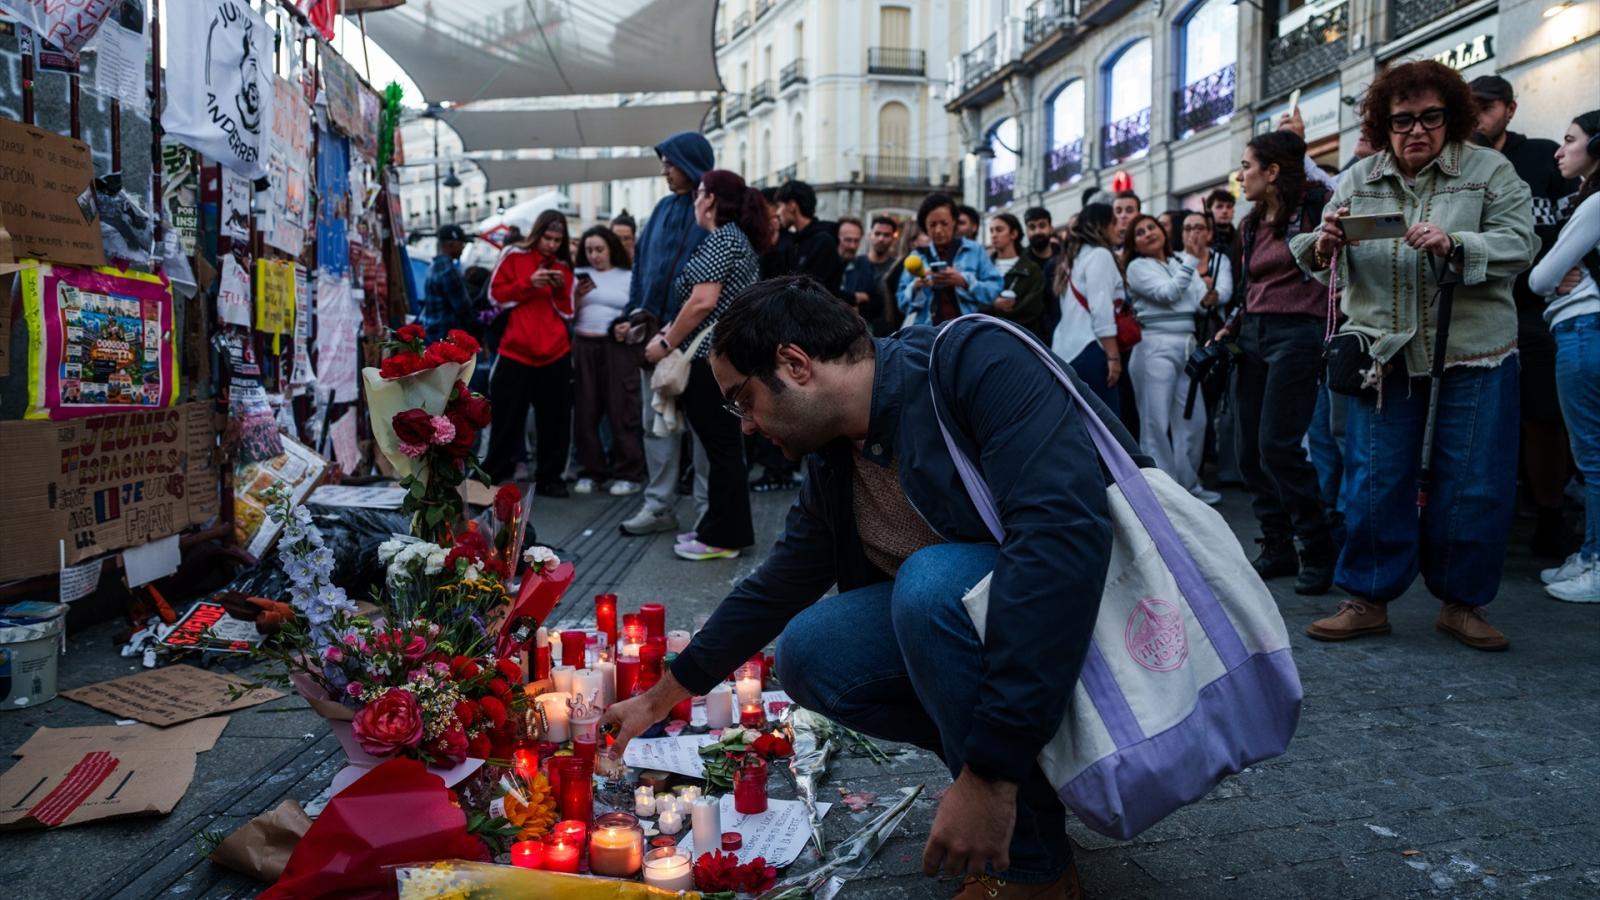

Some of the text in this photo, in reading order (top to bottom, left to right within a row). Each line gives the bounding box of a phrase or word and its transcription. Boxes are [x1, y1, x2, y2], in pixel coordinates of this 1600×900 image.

[206, 92, 259, 163] ANDERREN
[80, 409, 180, 457] JEUNES
[79, 448, 178, 485] ESPAGNOLS
